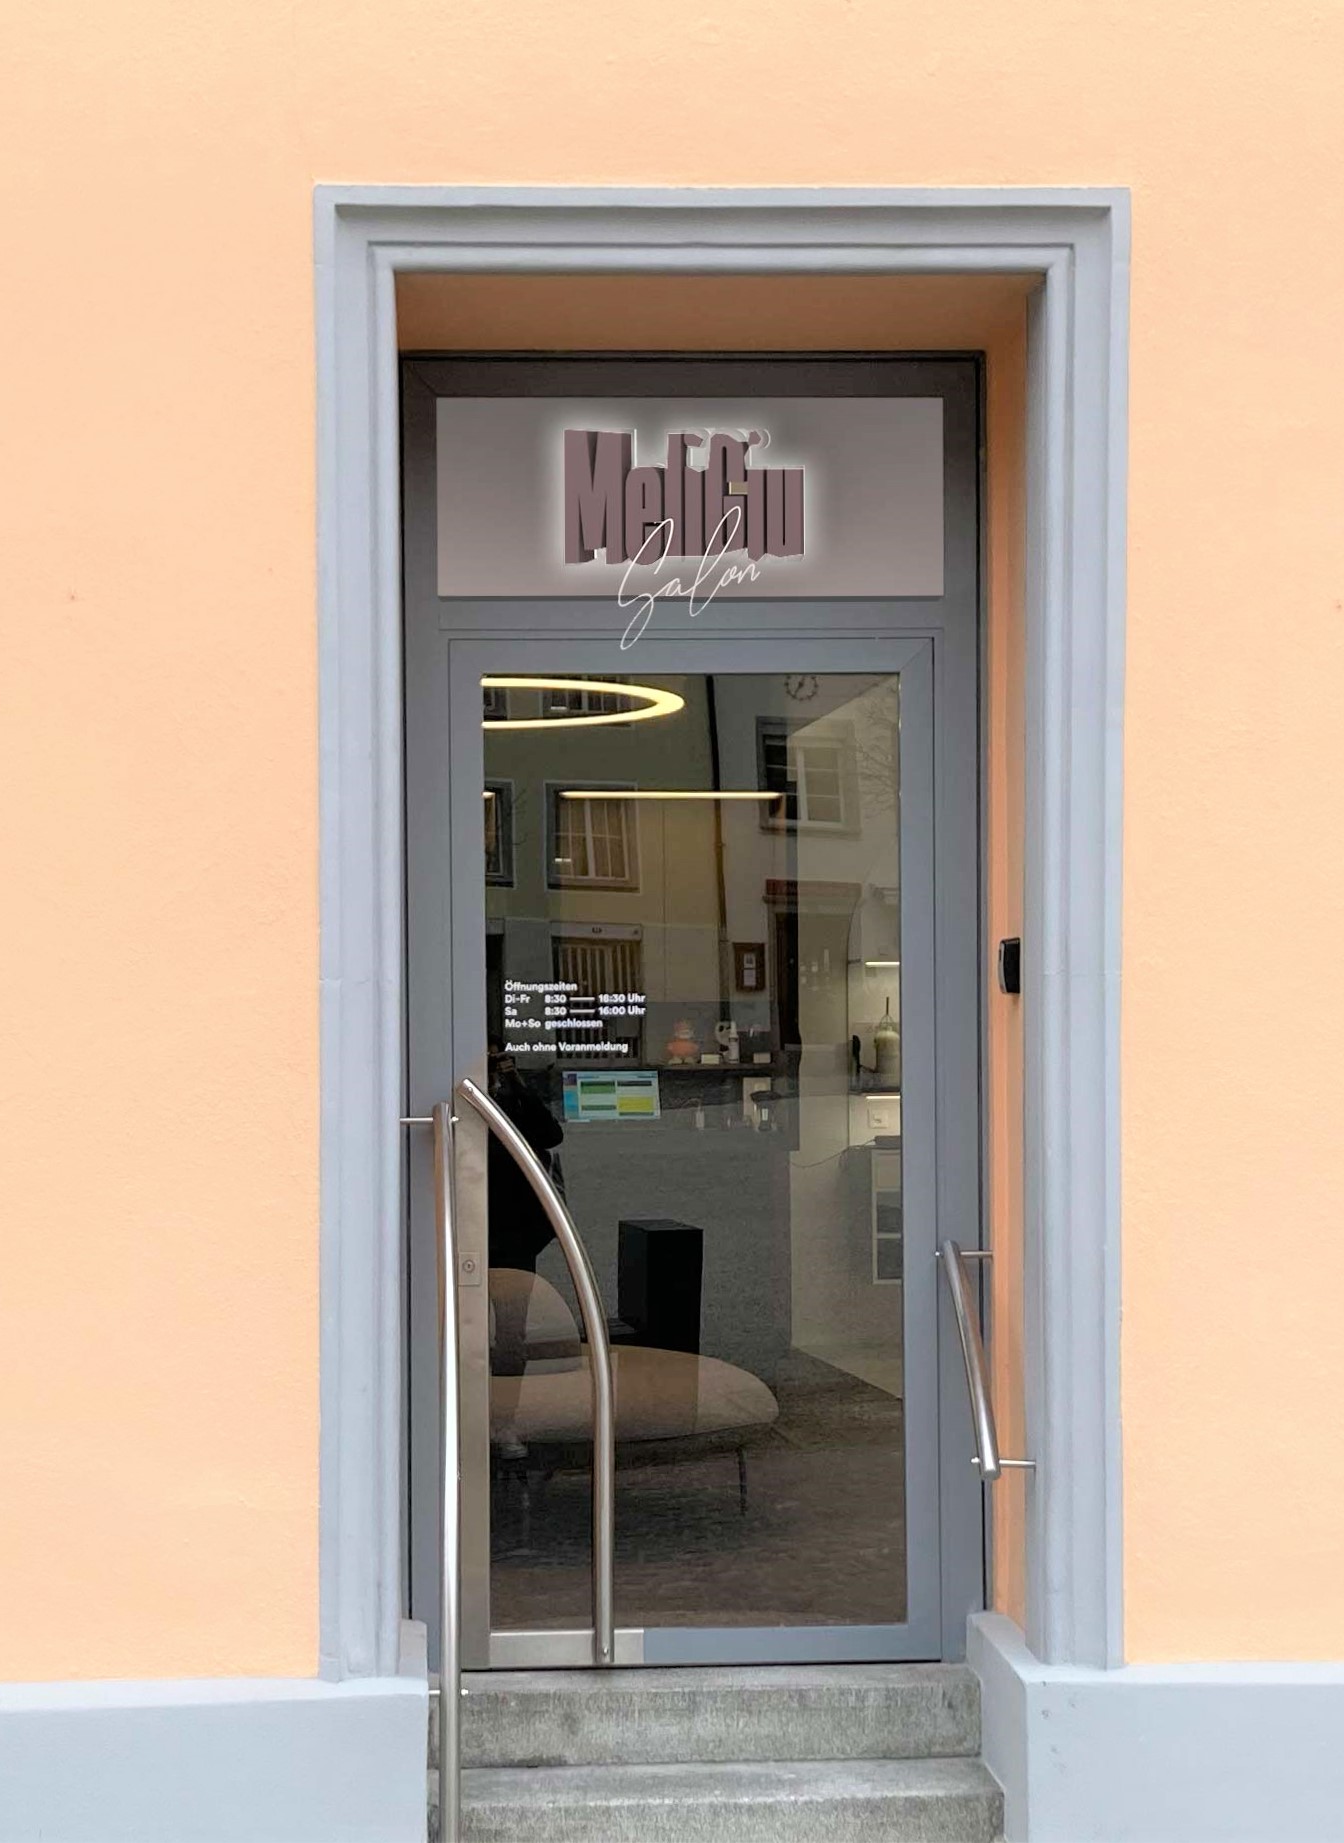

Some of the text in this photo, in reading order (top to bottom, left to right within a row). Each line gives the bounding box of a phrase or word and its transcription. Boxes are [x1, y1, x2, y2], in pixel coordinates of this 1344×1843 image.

[564, 428, 806, 566] MeliGiu
[617, 505, 761, 651] Salon
[504, 980, 578, 993] Öffnungszeiten
[504, 995, 531, 1004] Di-Fr
[544, 994, 567, 1004] 8:30
[598, 993, 626, 1003] 18:30
[628, 993, 646, 1003] Uhr
[504, 1007, 517, 1016] Sa
[544, 1006, 567, 1016] 8:30
[598, 1006, 626, 1016] 16:00
[627, 1006, 646, 1015] Uhr
[504, 1018, 603, 1030] Mo+So geschlossen
[504, 1042, 629, 1053] Auch ohne Voranmeldung
